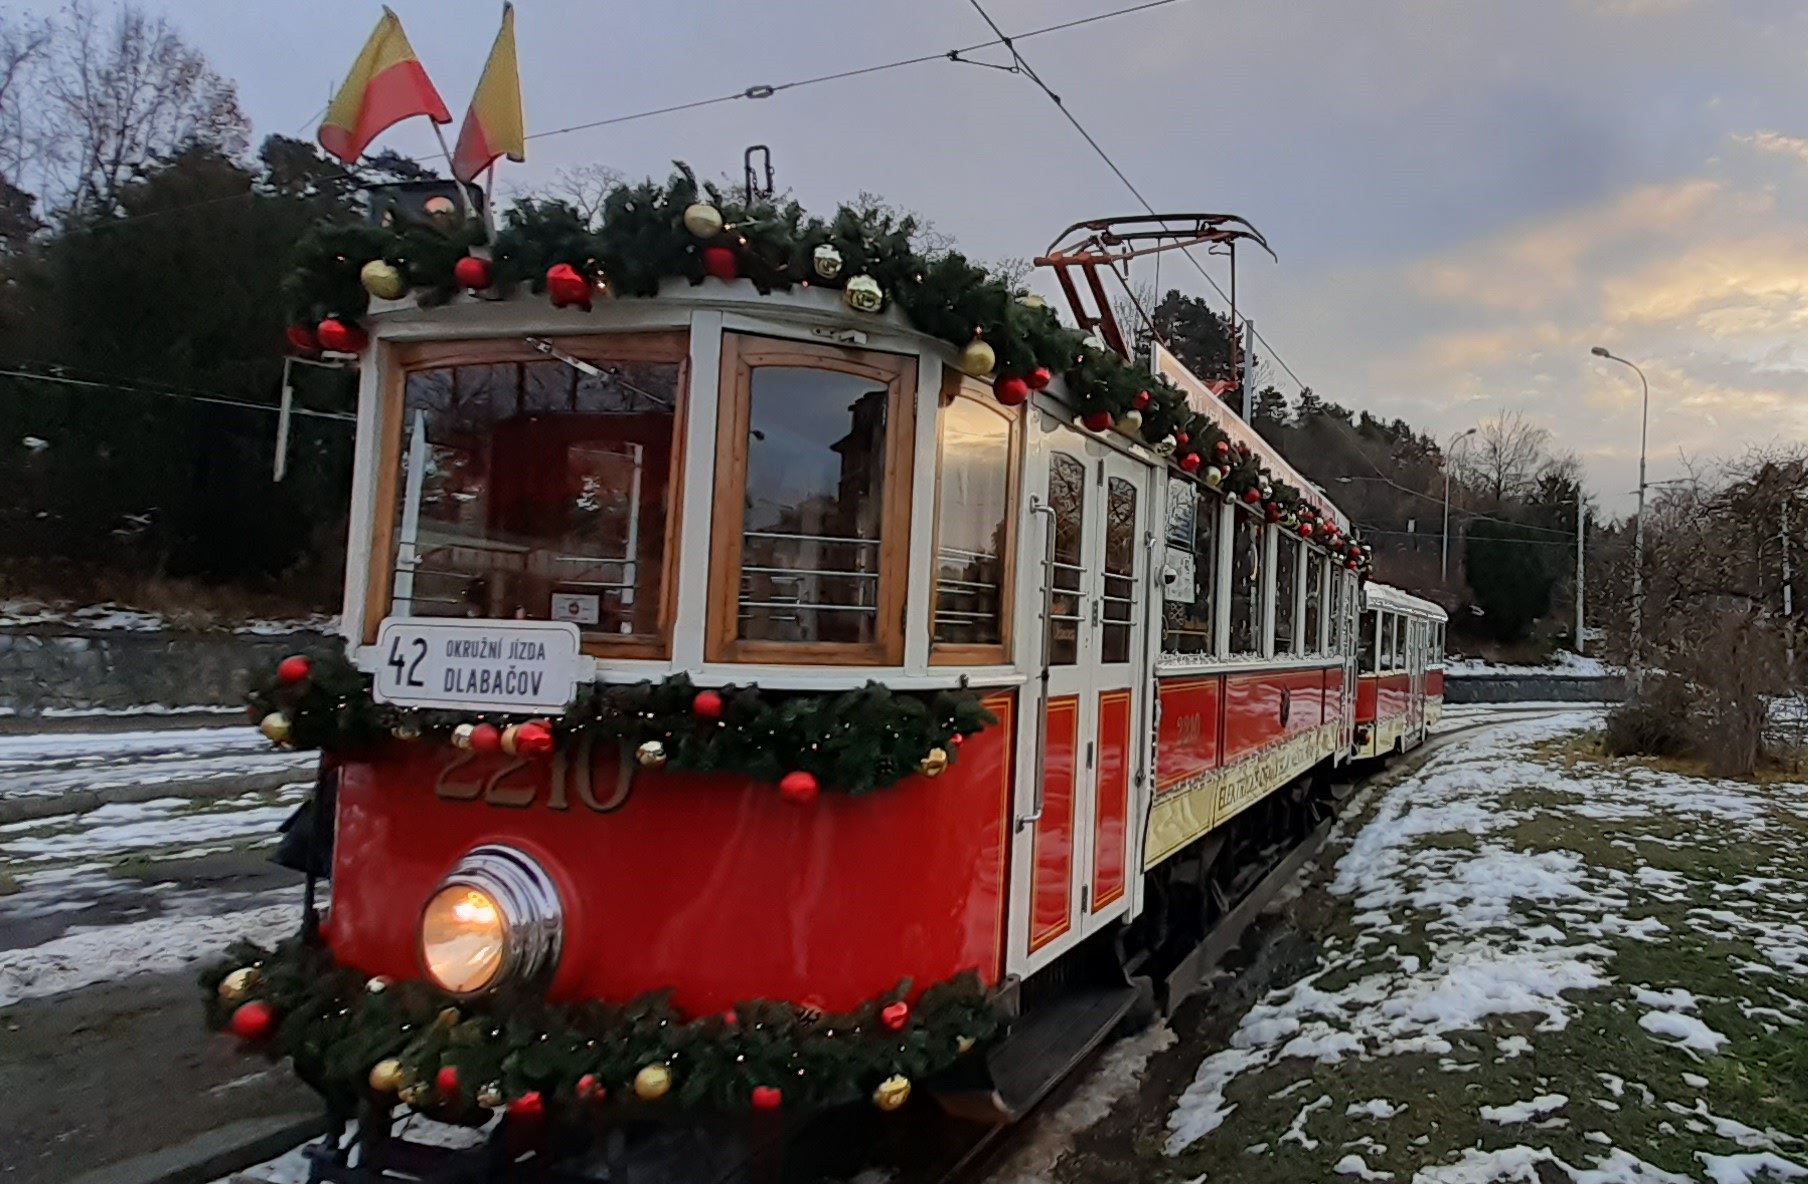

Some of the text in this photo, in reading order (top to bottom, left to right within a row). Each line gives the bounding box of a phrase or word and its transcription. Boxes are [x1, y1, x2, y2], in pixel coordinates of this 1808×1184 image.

[387, 636, 428, 687] 42
[446, 637, 546, 660] OKRUŽNÍ JÍZDA
[443, 665, 543, 696] DLABAČOV
